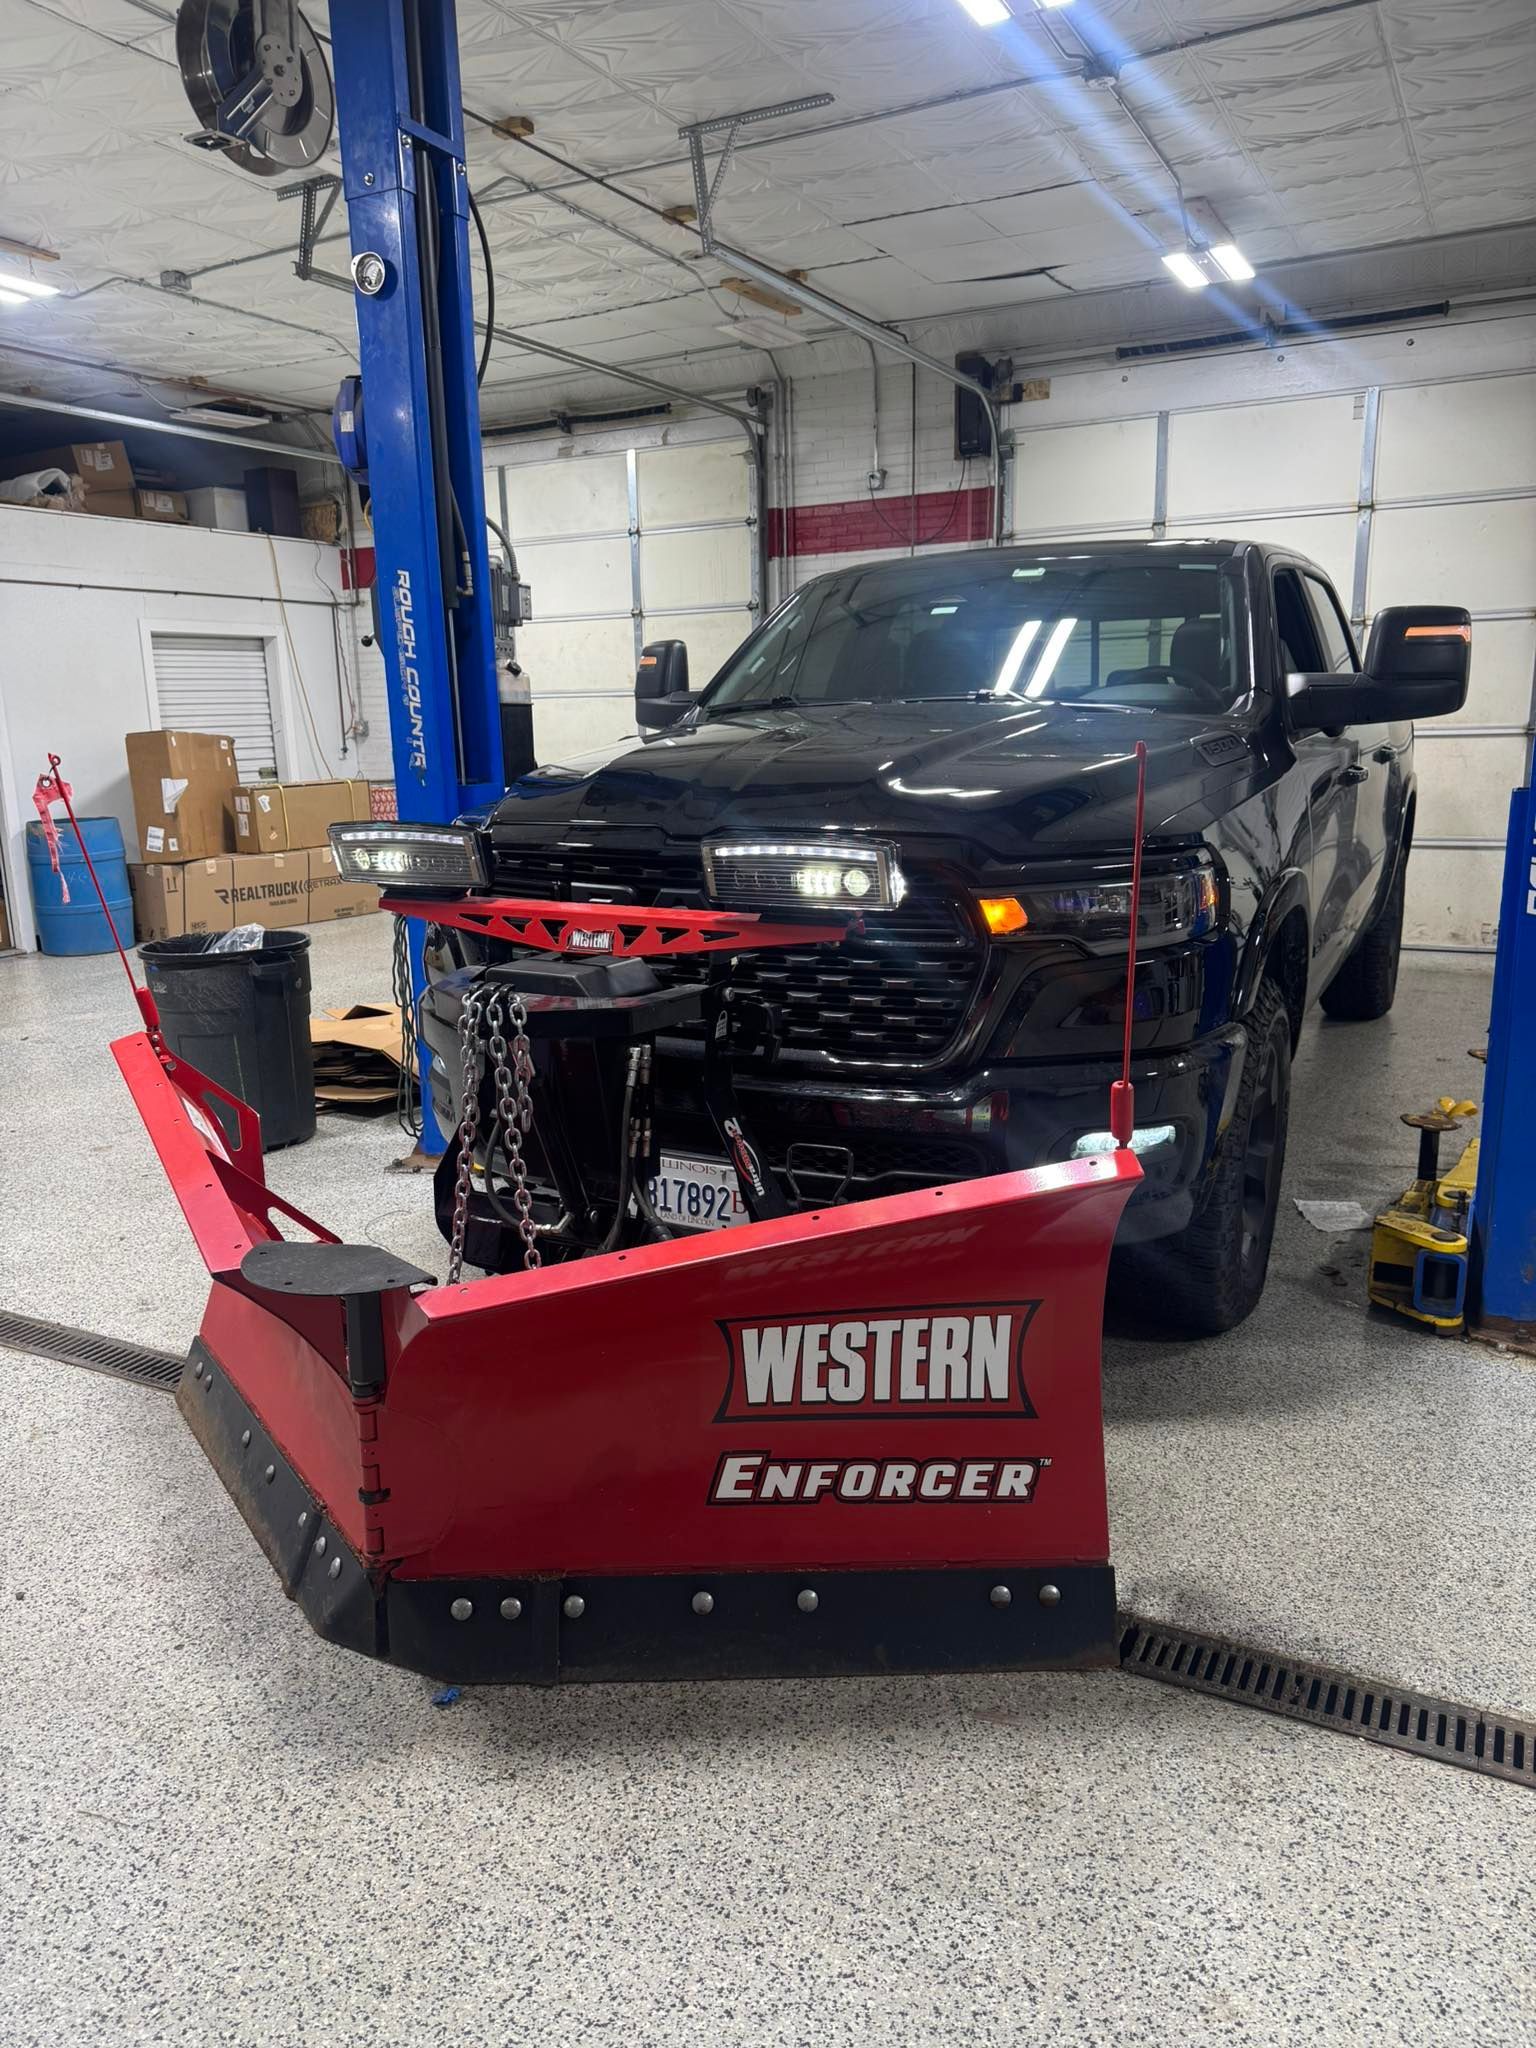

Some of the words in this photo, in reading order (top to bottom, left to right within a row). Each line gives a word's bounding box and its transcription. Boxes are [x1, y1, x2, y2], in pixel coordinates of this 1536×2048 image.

[397, 569, 417, 659] ROUGH
[231, 881, 298, 903] REALTRUCK
[572, 930, 610, 949] WESTERN
[661, 1158, 717, 1176] LLINOIS
[742, 1314, 1012, 1404] WESTERN
[712, 1455, 1037, 1501] ENFORCER
